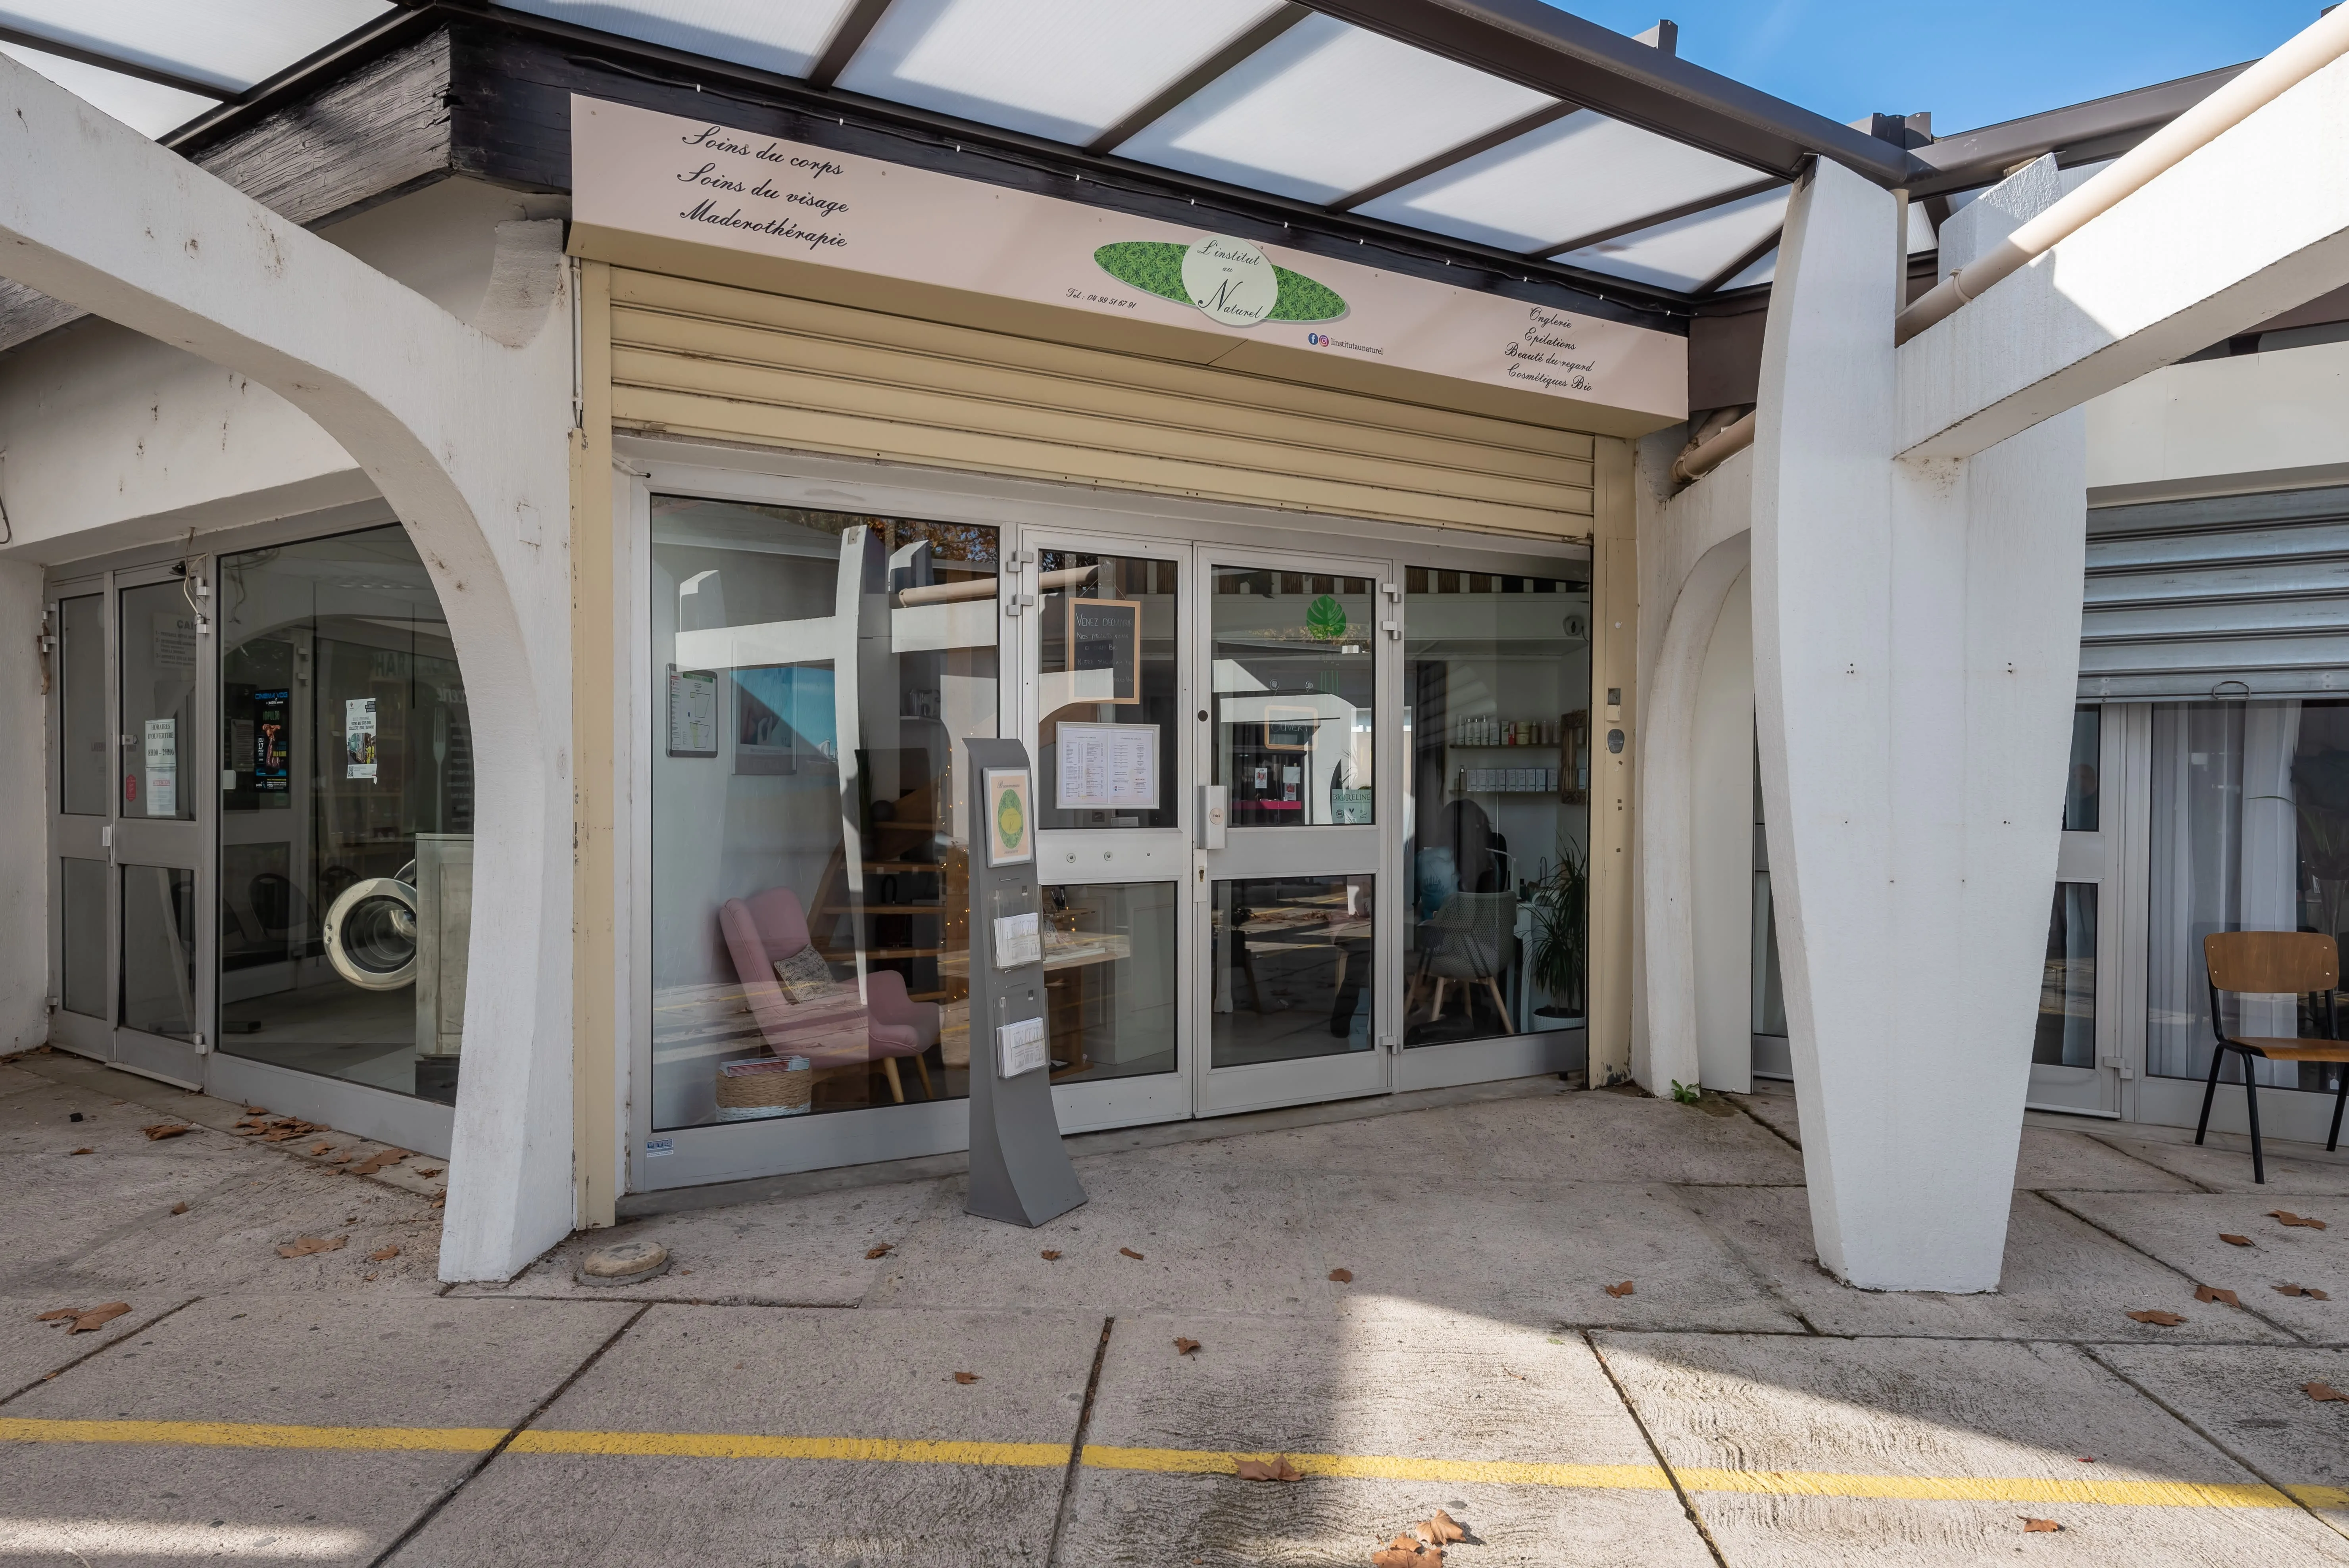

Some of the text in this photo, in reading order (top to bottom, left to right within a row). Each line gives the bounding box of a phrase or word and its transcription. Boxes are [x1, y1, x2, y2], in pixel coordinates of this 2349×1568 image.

[682, 126, 844, 179] Soins du corps
[677, 163, 849, 217] Soins du visage
[679, 198, 848, 250] Maderothérapie
[1196, 240, 1260, 265] L'institut
[1198, 279, 1263, 318] Naturel
[1530, 307, 1572, 328] Onglerie
[1331, 338, 1383, 355] linstitutaunaturel
[1524, 327, 1576, 350] Epilations
[1505, 342, 1595, 373] Beauté du regard
[1507, 363, 1593, 391] Cosmétiques Bio
